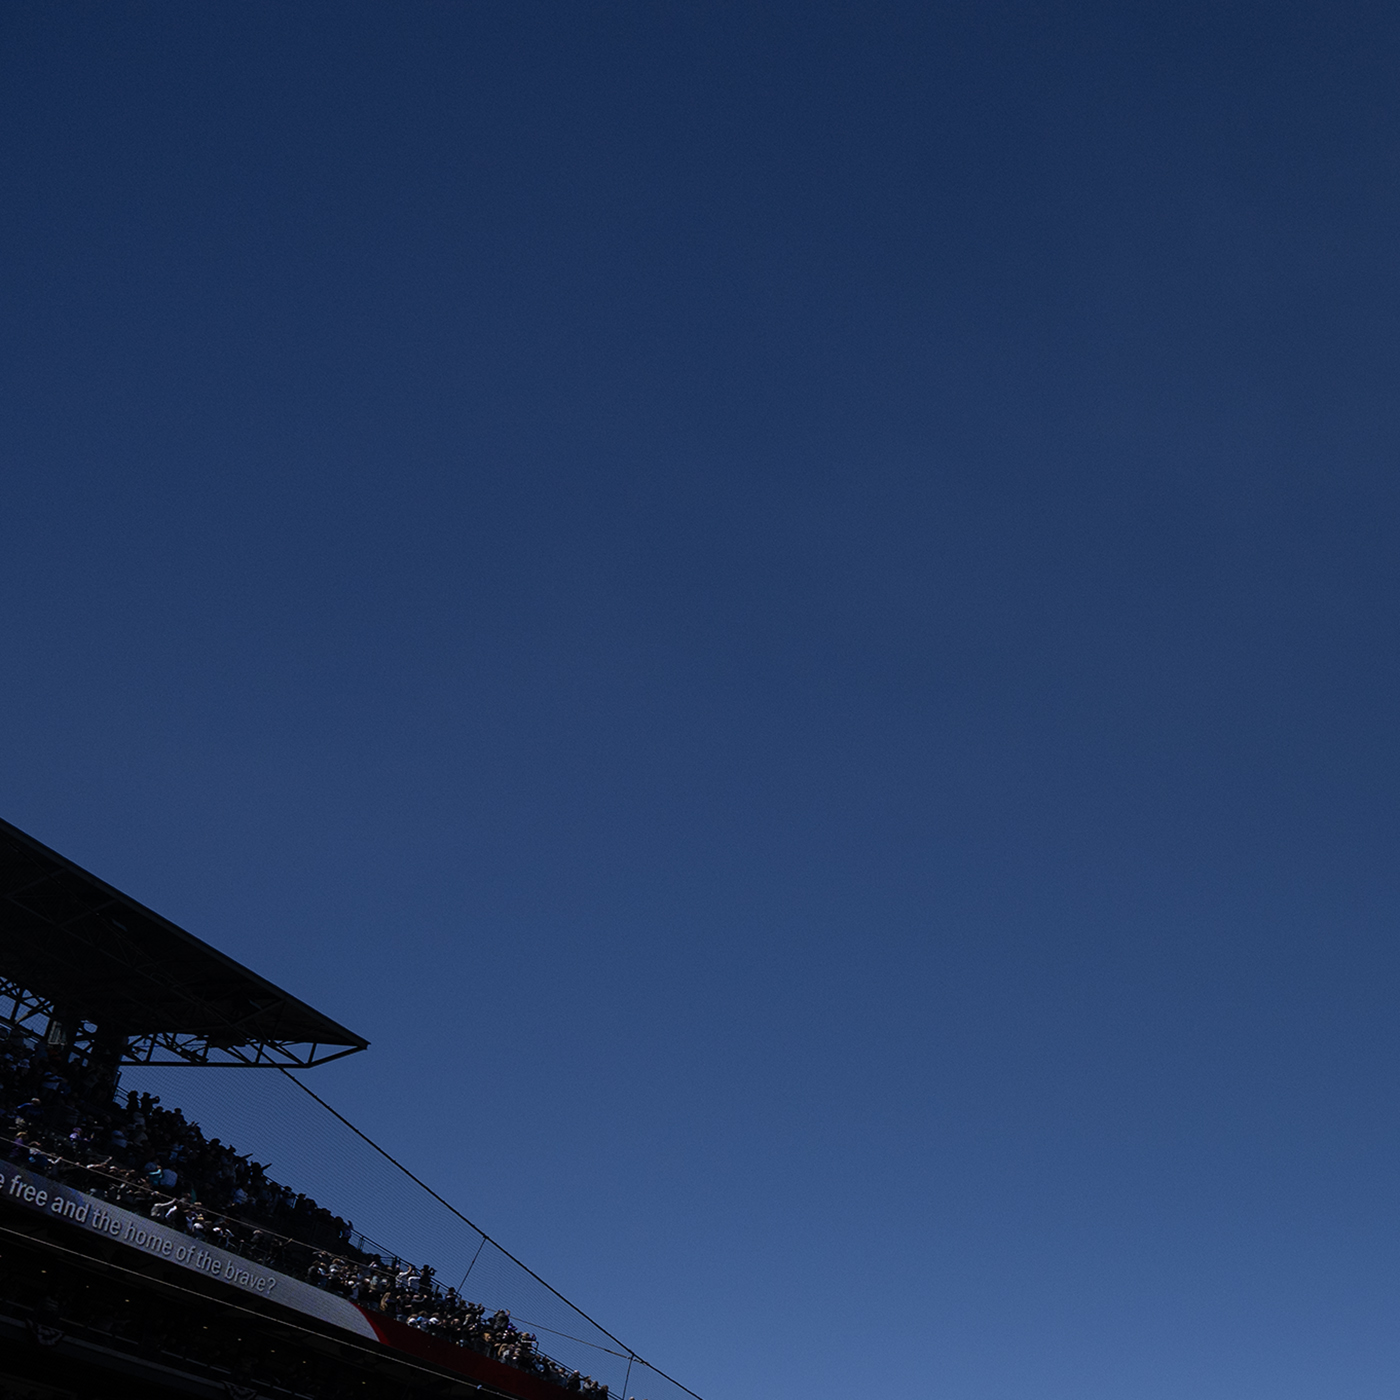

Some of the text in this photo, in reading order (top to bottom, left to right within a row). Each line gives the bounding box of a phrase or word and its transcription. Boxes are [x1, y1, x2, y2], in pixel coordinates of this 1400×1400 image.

[9, 1176, 48, 1206] free
[51, 1197, 90, 1223] and
[91, 1208, 121, 1236] the
[124, 1223, 173, 1256] home
[176, 1244, 196, 1263] of
[196, 1248, 222, 1275] the
[224, 1262, 277, 1293] brave?
